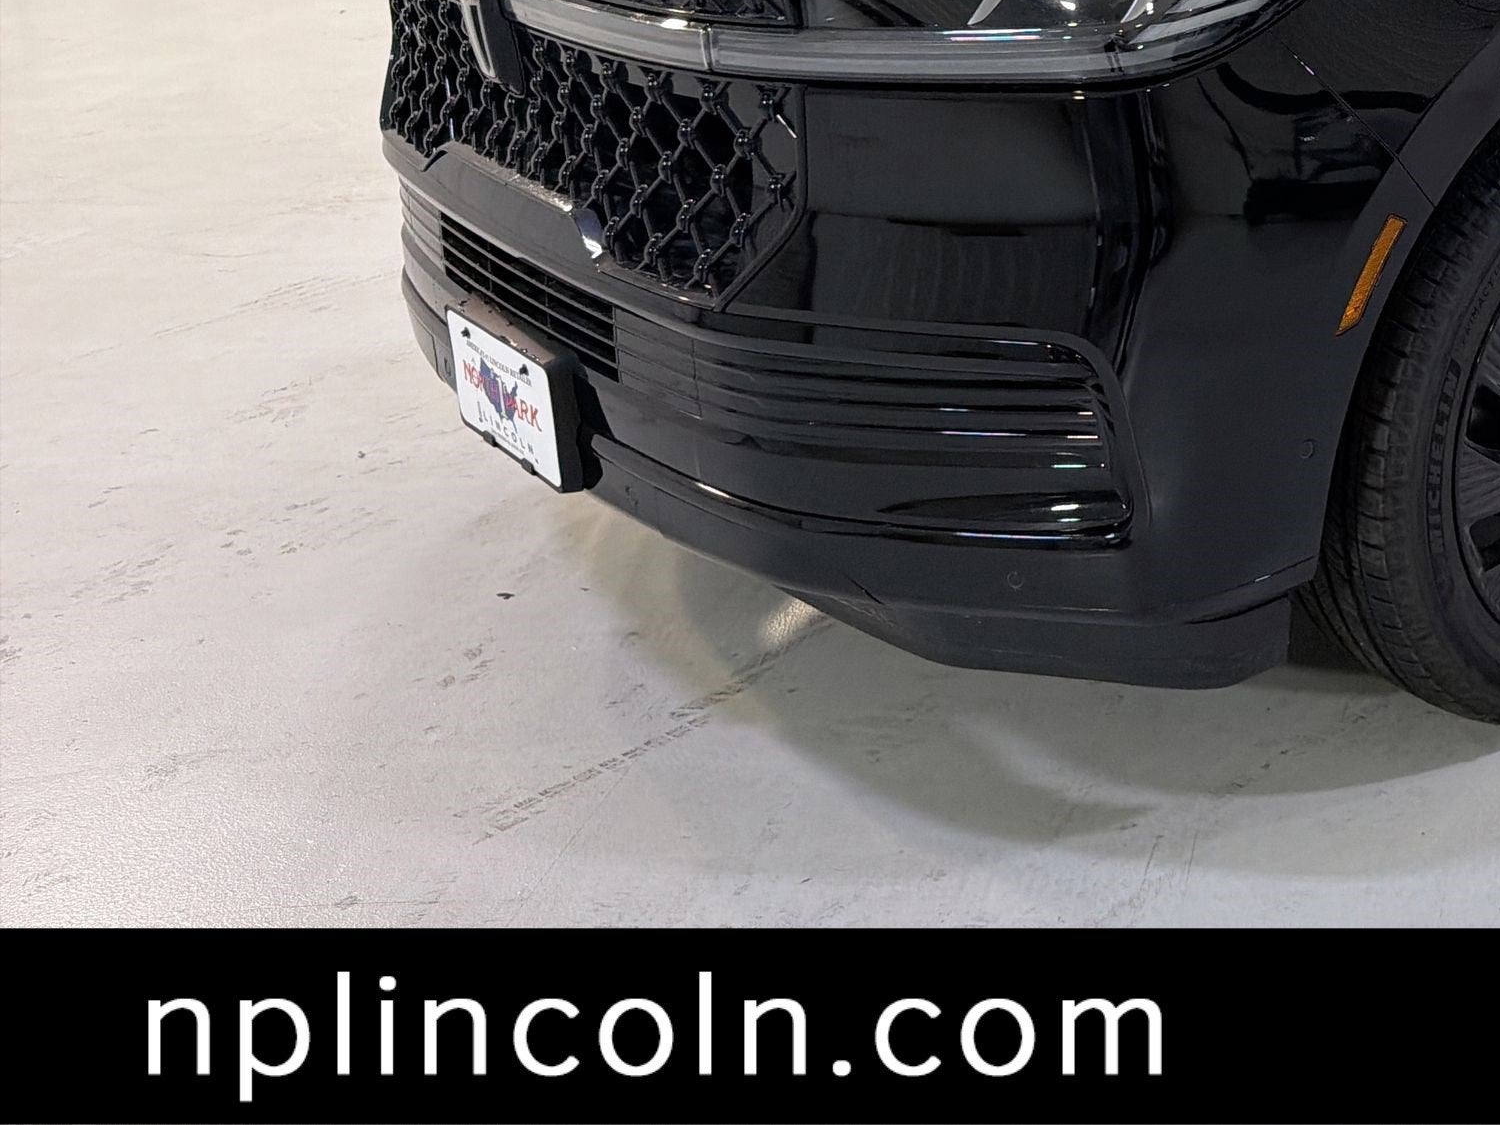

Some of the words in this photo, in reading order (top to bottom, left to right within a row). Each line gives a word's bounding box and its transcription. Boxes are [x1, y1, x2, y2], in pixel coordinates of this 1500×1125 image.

[463, 358, 499, 399] NORTH
[504, 391, 542, 432] PARK
[483, 411, 534, 455] LINCOLN
[1427, 366, 1458, 555] MICHELIN
